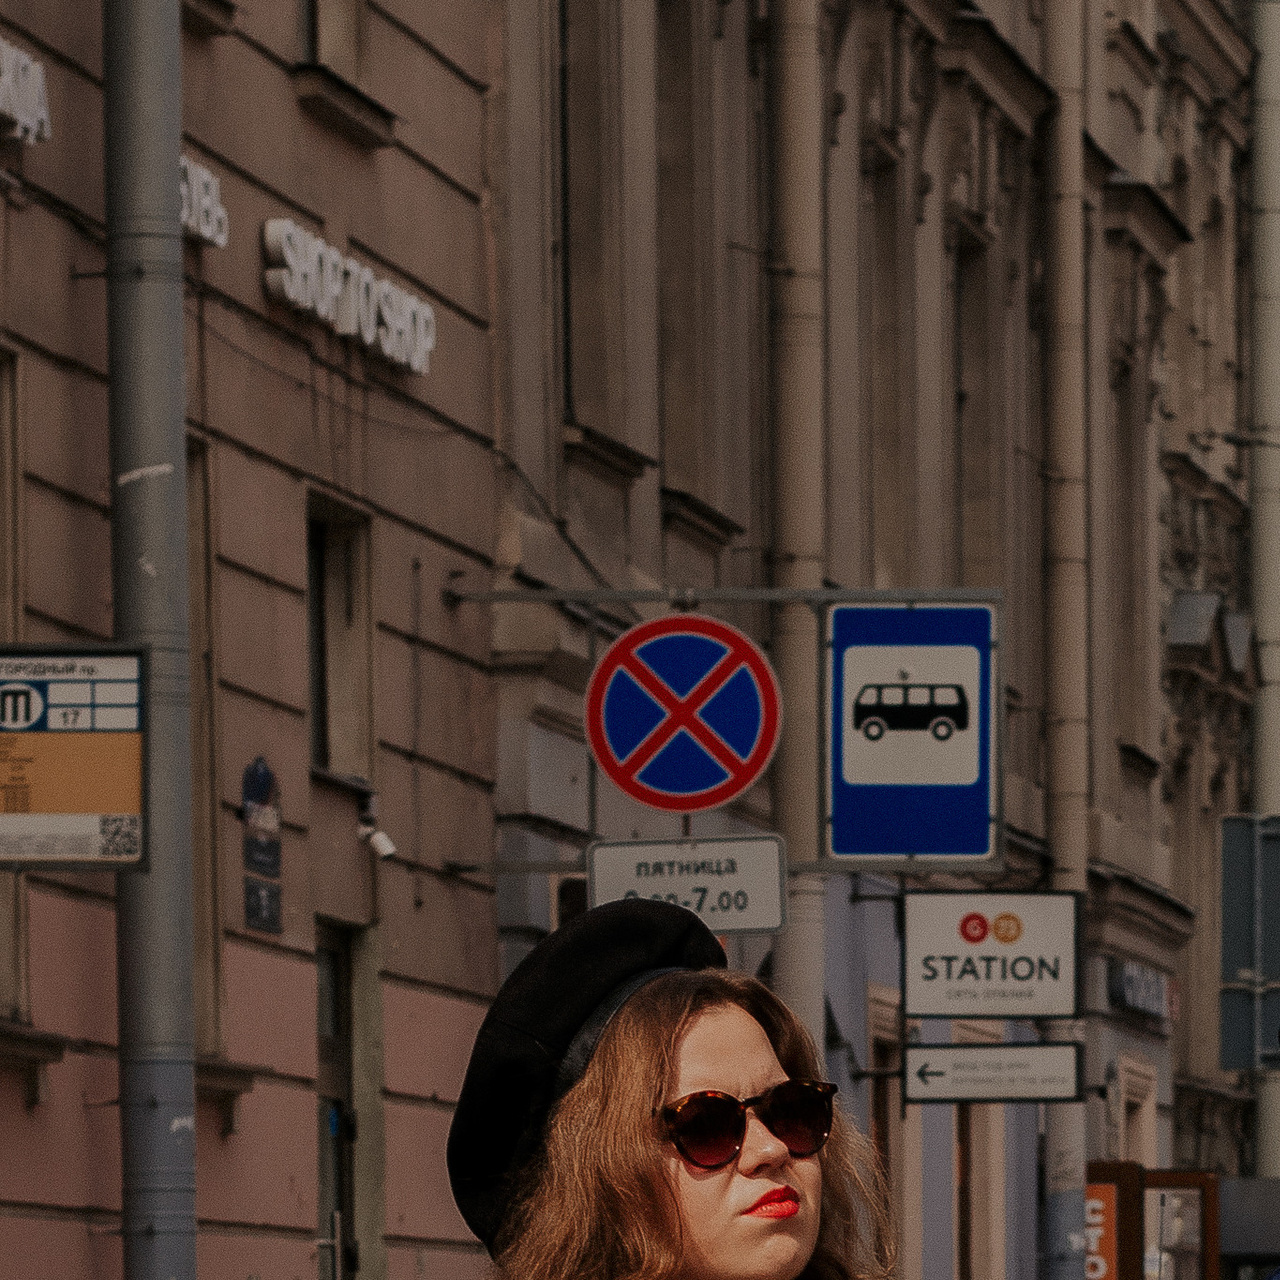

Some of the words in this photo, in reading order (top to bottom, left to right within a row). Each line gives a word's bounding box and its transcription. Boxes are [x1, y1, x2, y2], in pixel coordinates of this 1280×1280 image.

[61, 710, 80, 726] 17
[623, 886, 749, 913] -7.00
[921, 955, 1060, 982] STATION
